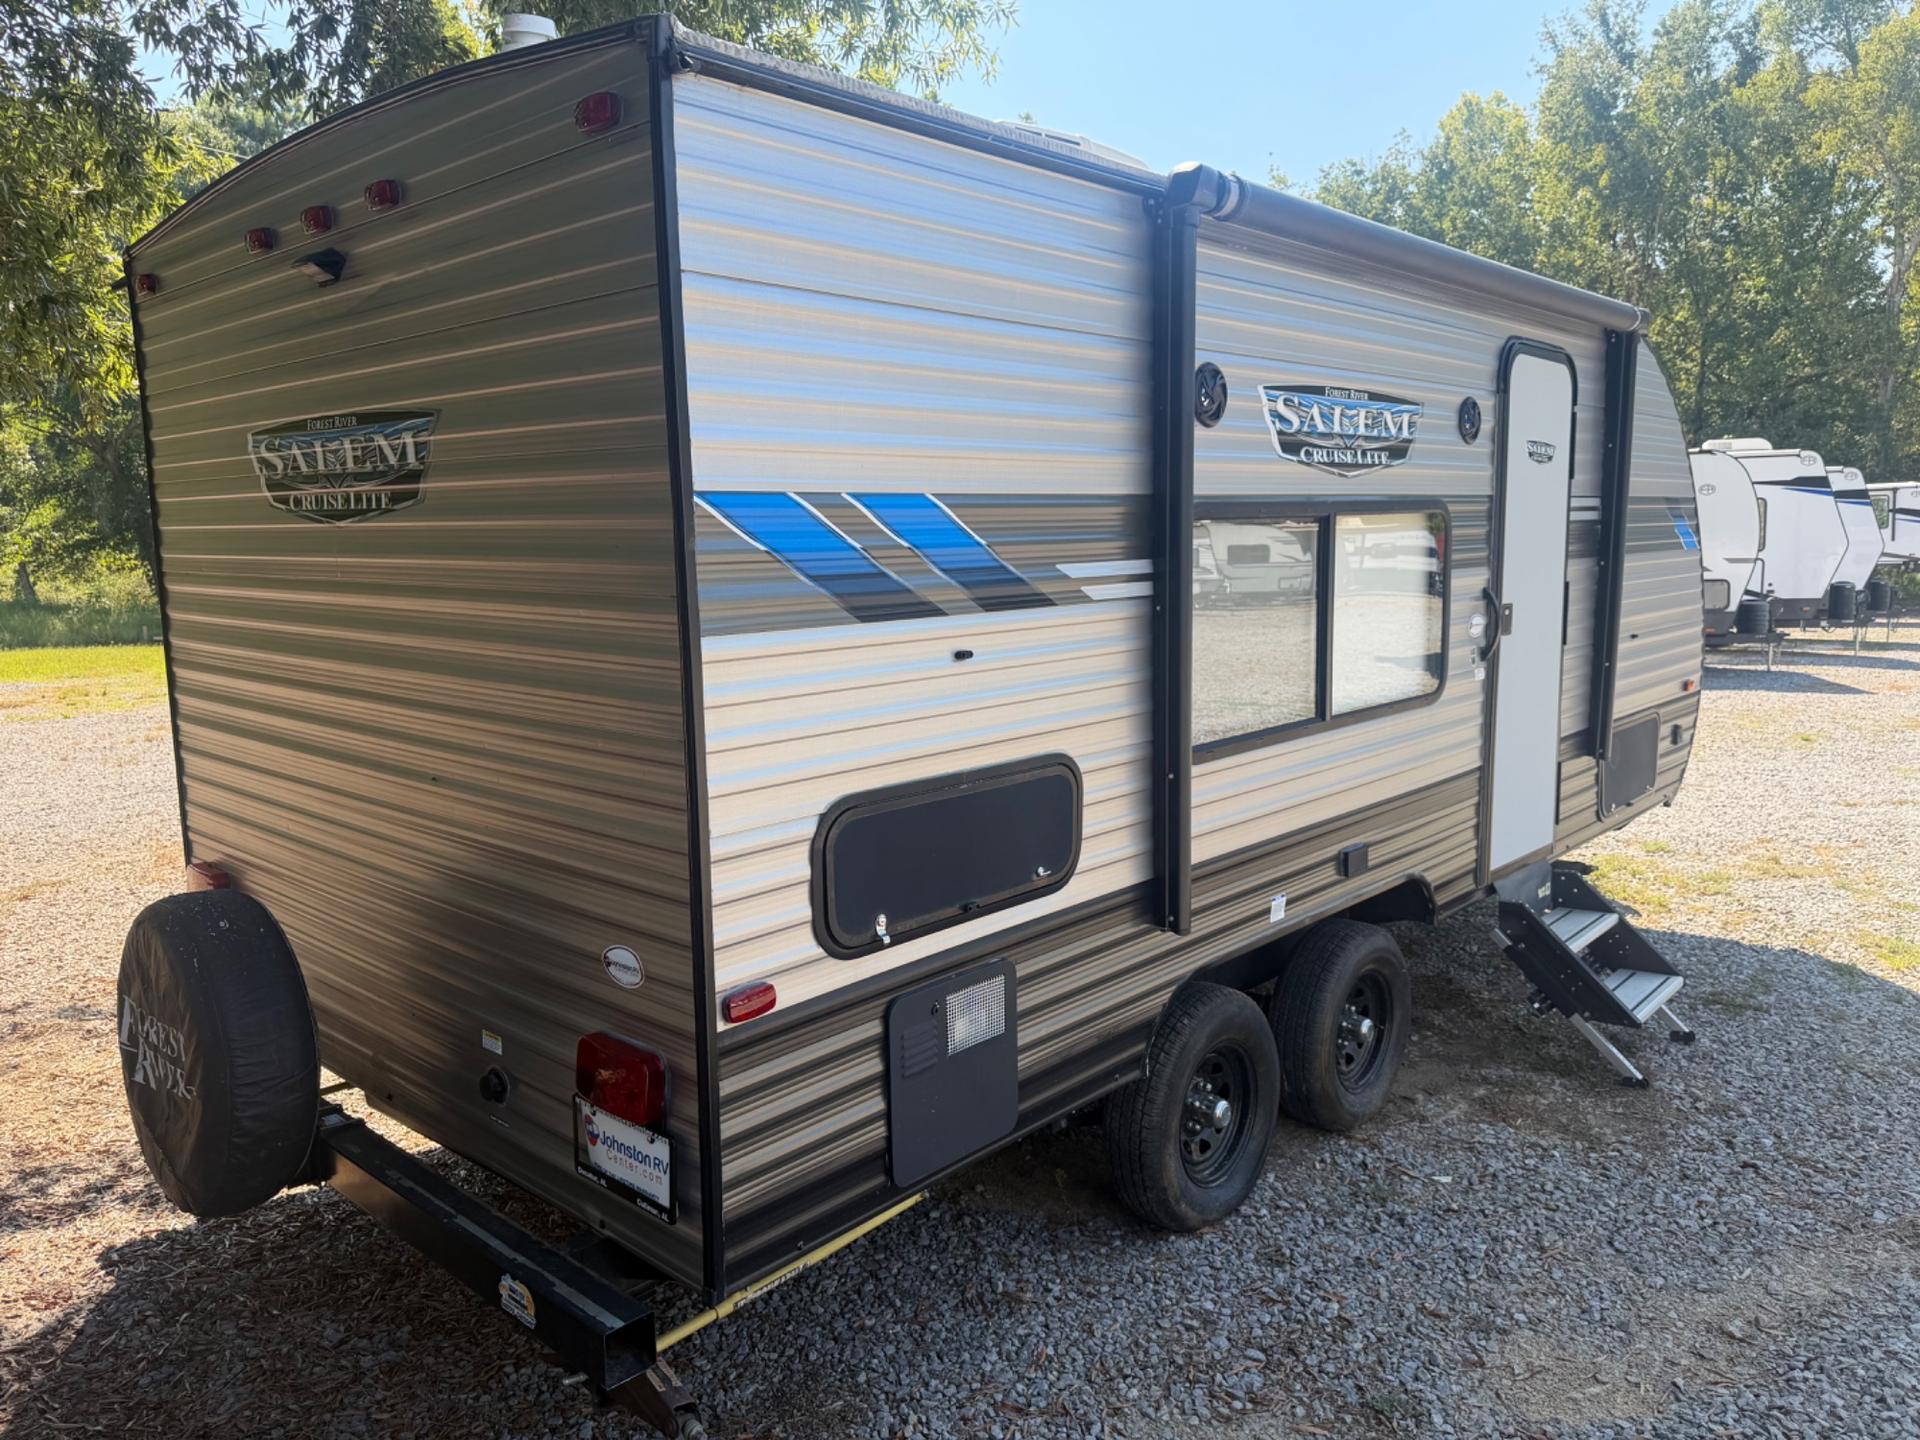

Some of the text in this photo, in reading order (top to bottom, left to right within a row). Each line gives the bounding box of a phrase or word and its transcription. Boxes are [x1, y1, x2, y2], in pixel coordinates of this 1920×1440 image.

[1325, 386, 1369, 401] FOREST RIVER
[307, 415, 358, 431] FOREST RIVER
[1275, 394, 1413, 439] SALEM
[259, 431, 428, 480] SALEM
[120, 994, 185, 1062] FOREST
[131, 1034, 193, 1100] RIVER
[600, 1130, 652, 1168] Johnston
[652, 1156, 669, 1176] RV
[606, 1149, 664, 1186] Center.com
